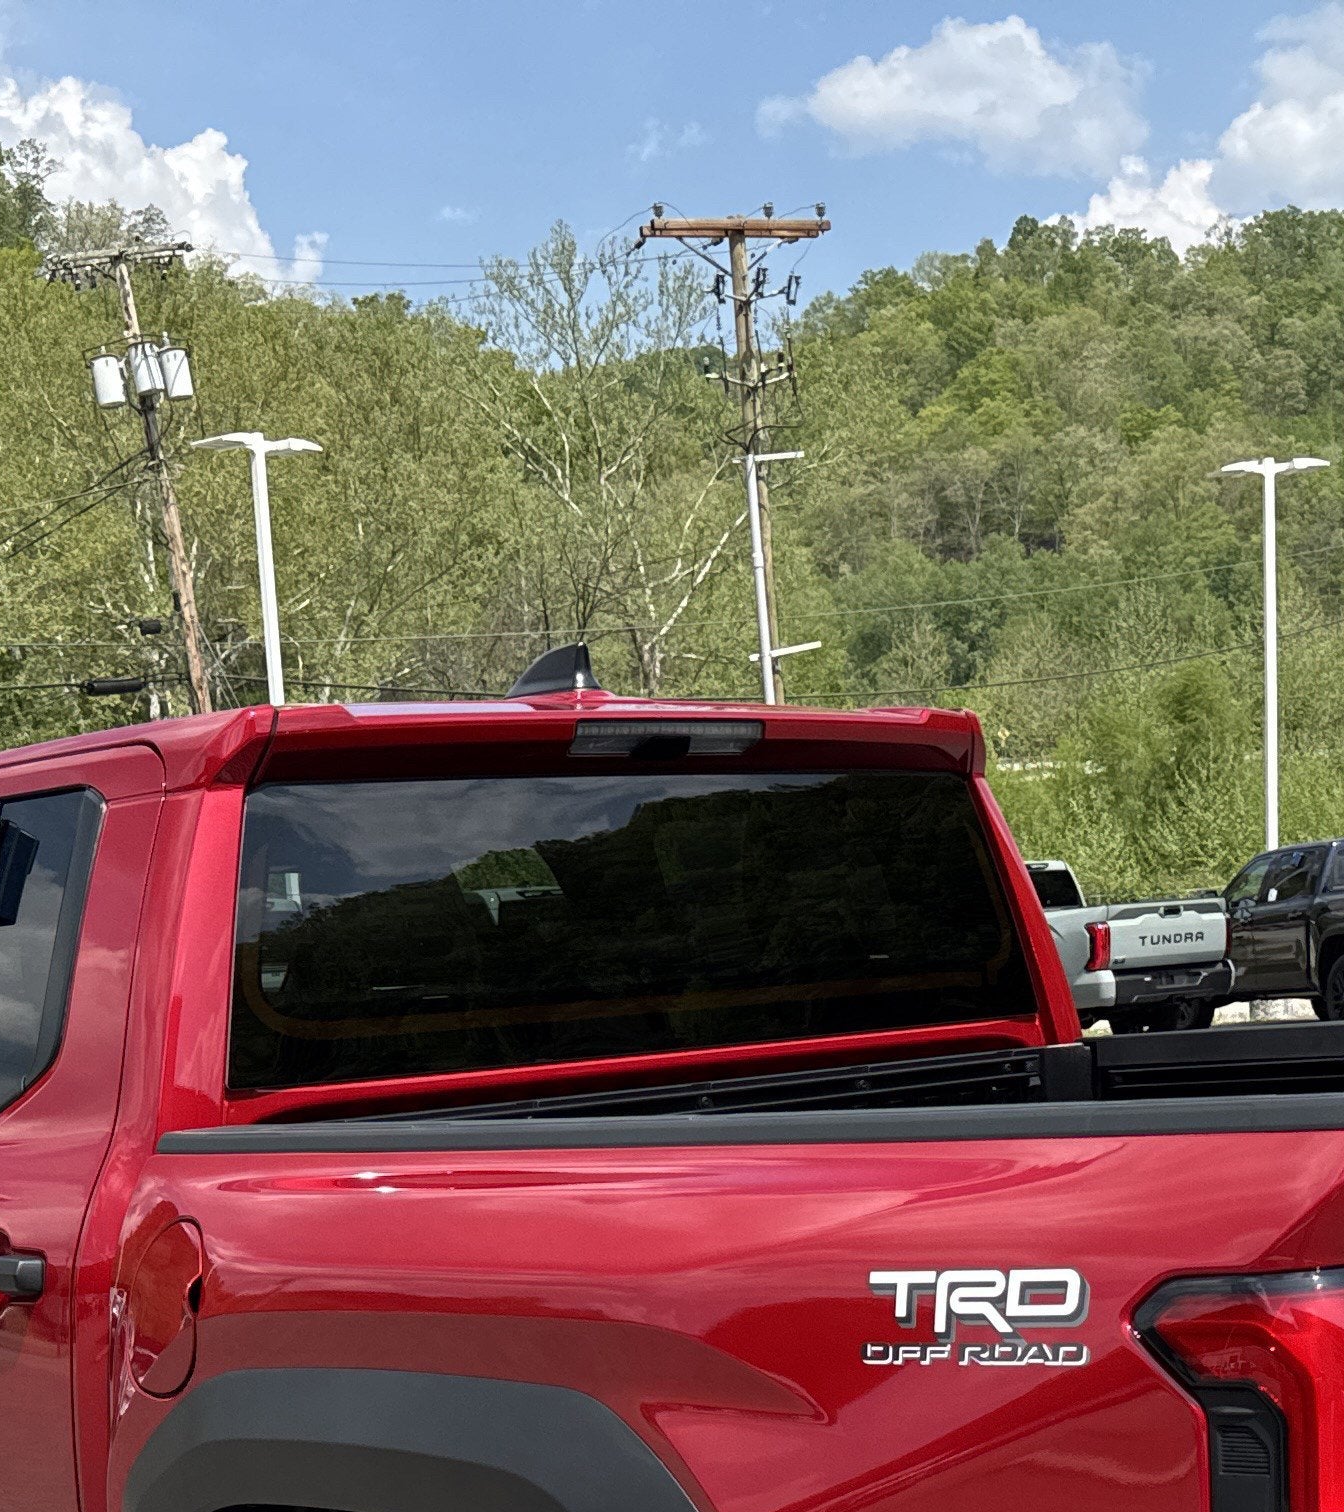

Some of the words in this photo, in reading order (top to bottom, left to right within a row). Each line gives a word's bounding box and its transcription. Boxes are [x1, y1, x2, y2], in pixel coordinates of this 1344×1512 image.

[1138, 931, 1205, 947] TUNDRA
[868, 1267, 1090, 1342] TRD
[861, 1343, 951, 1366] OFF
[958, 1343, 1091, 1367] ROAD
